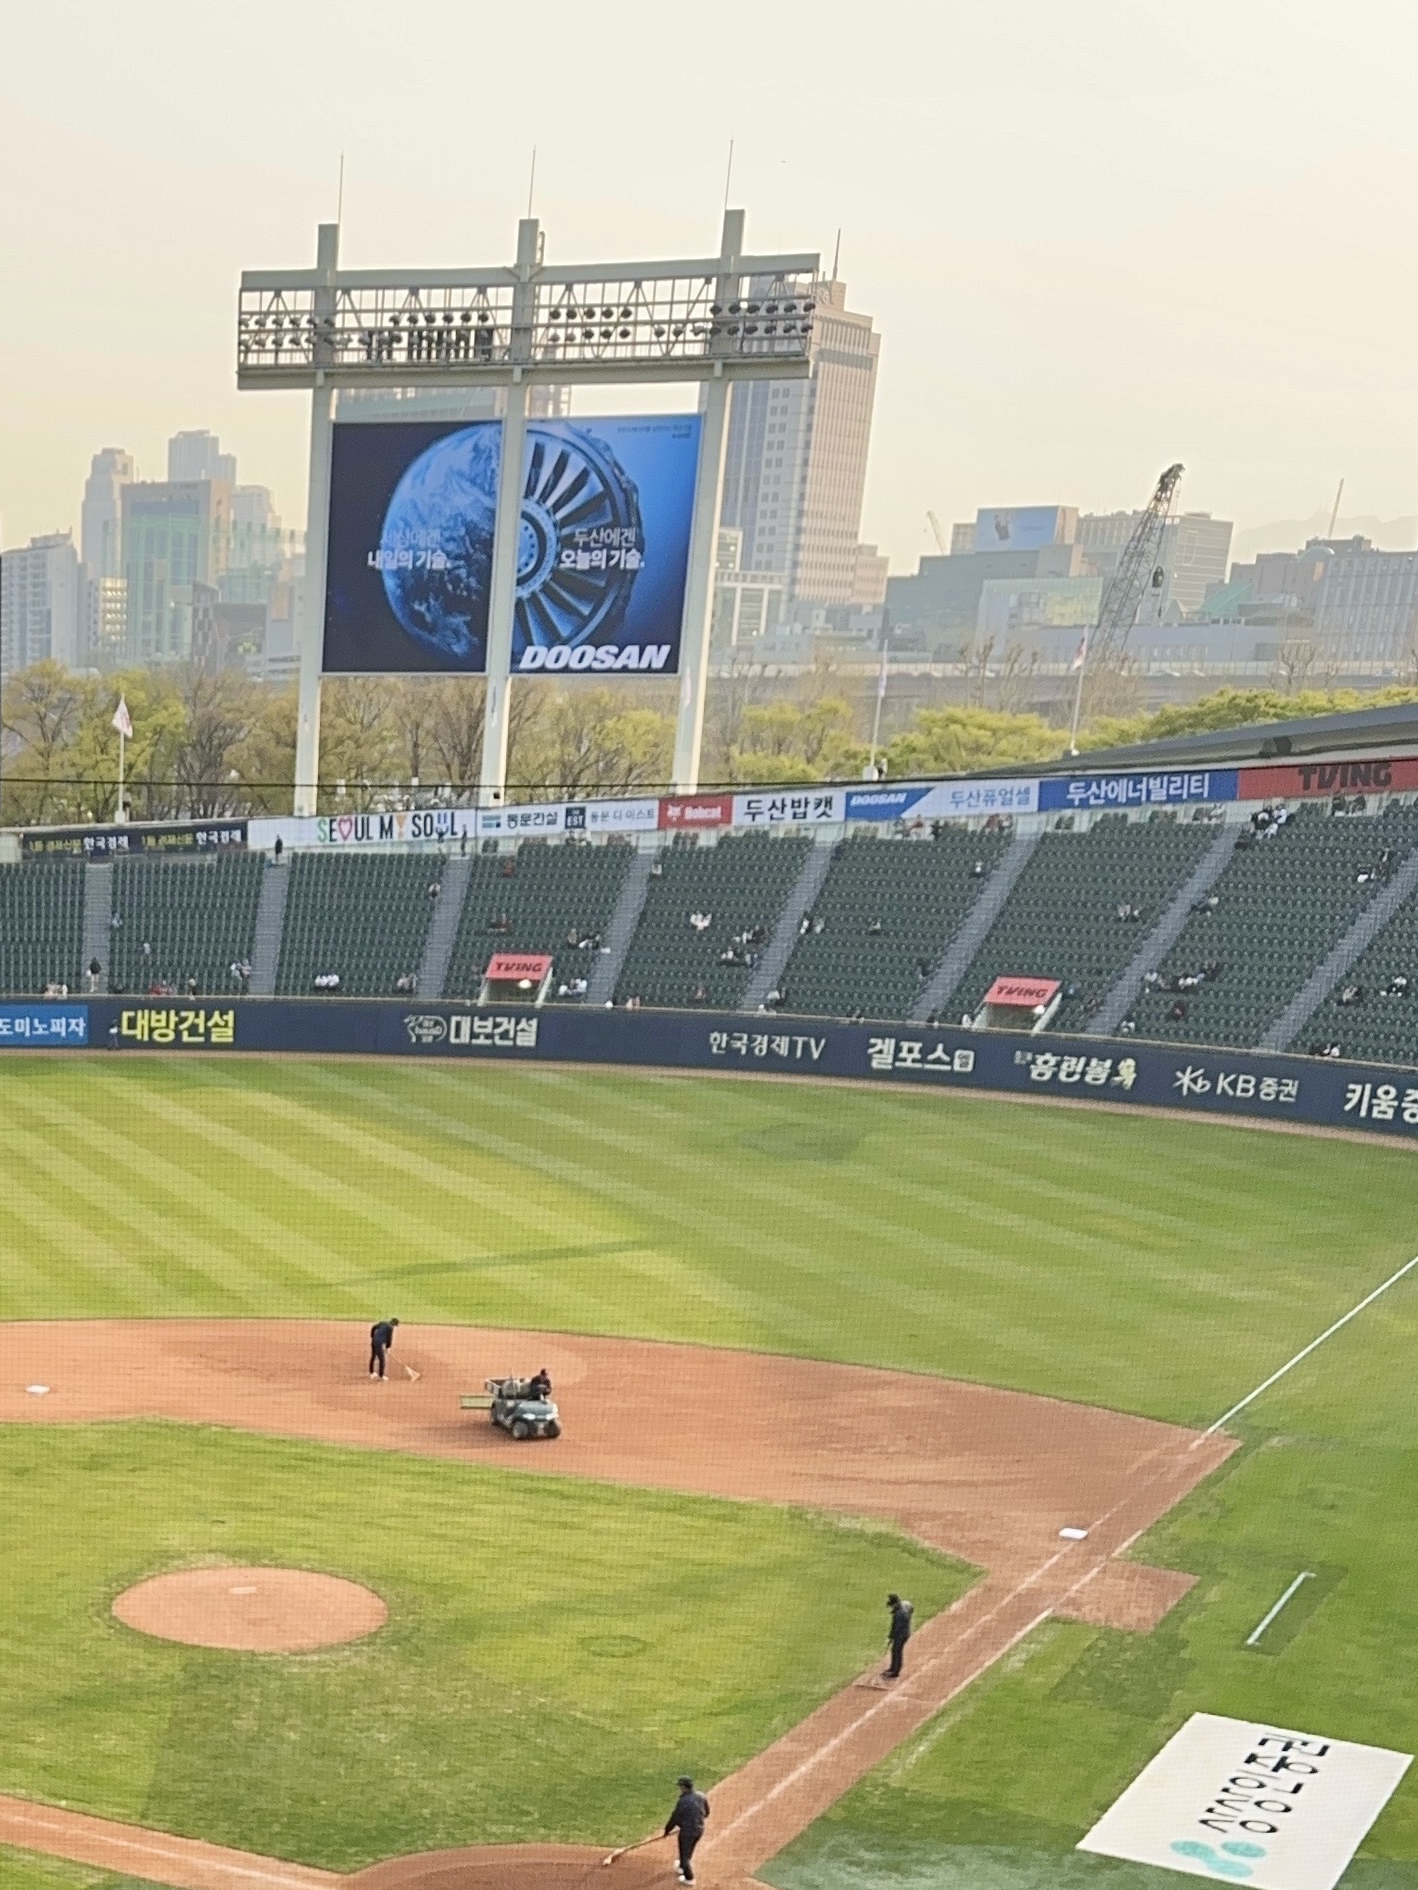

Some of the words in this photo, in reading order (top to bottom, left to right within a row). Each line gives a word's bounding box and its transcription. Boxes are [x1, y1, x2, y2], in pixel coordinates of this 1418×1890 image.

[573, 527, 636, 549] 두산에겐
[367, 549, 413, 570] 내일의
[559, 549, 607, 570] 오늘의
[519, 644, 671, 670] DOOSAN
[1298, 762, 1392, 791] TVING
[850, 792, 907, 807] DOOSAN
[949, 787, 1031, 809] 두산퓨얼셀
[1066, 773, 1210, 805] 두산에너빌리티
[507, 811, 559, 829] 동문건설
[744, 795, 833, 822] 두산밥캣
[495, 961, 542, 974] TVING
[995, 984, 1048, 1000] TVING
[120, 1010, 235, 1043] 대방건설
[449, 1015, 538, 1047] 대보건설
[709, 1031, 826, 1060] 한국경제TV
[868, 1037, 951, 1072] 겔포스
